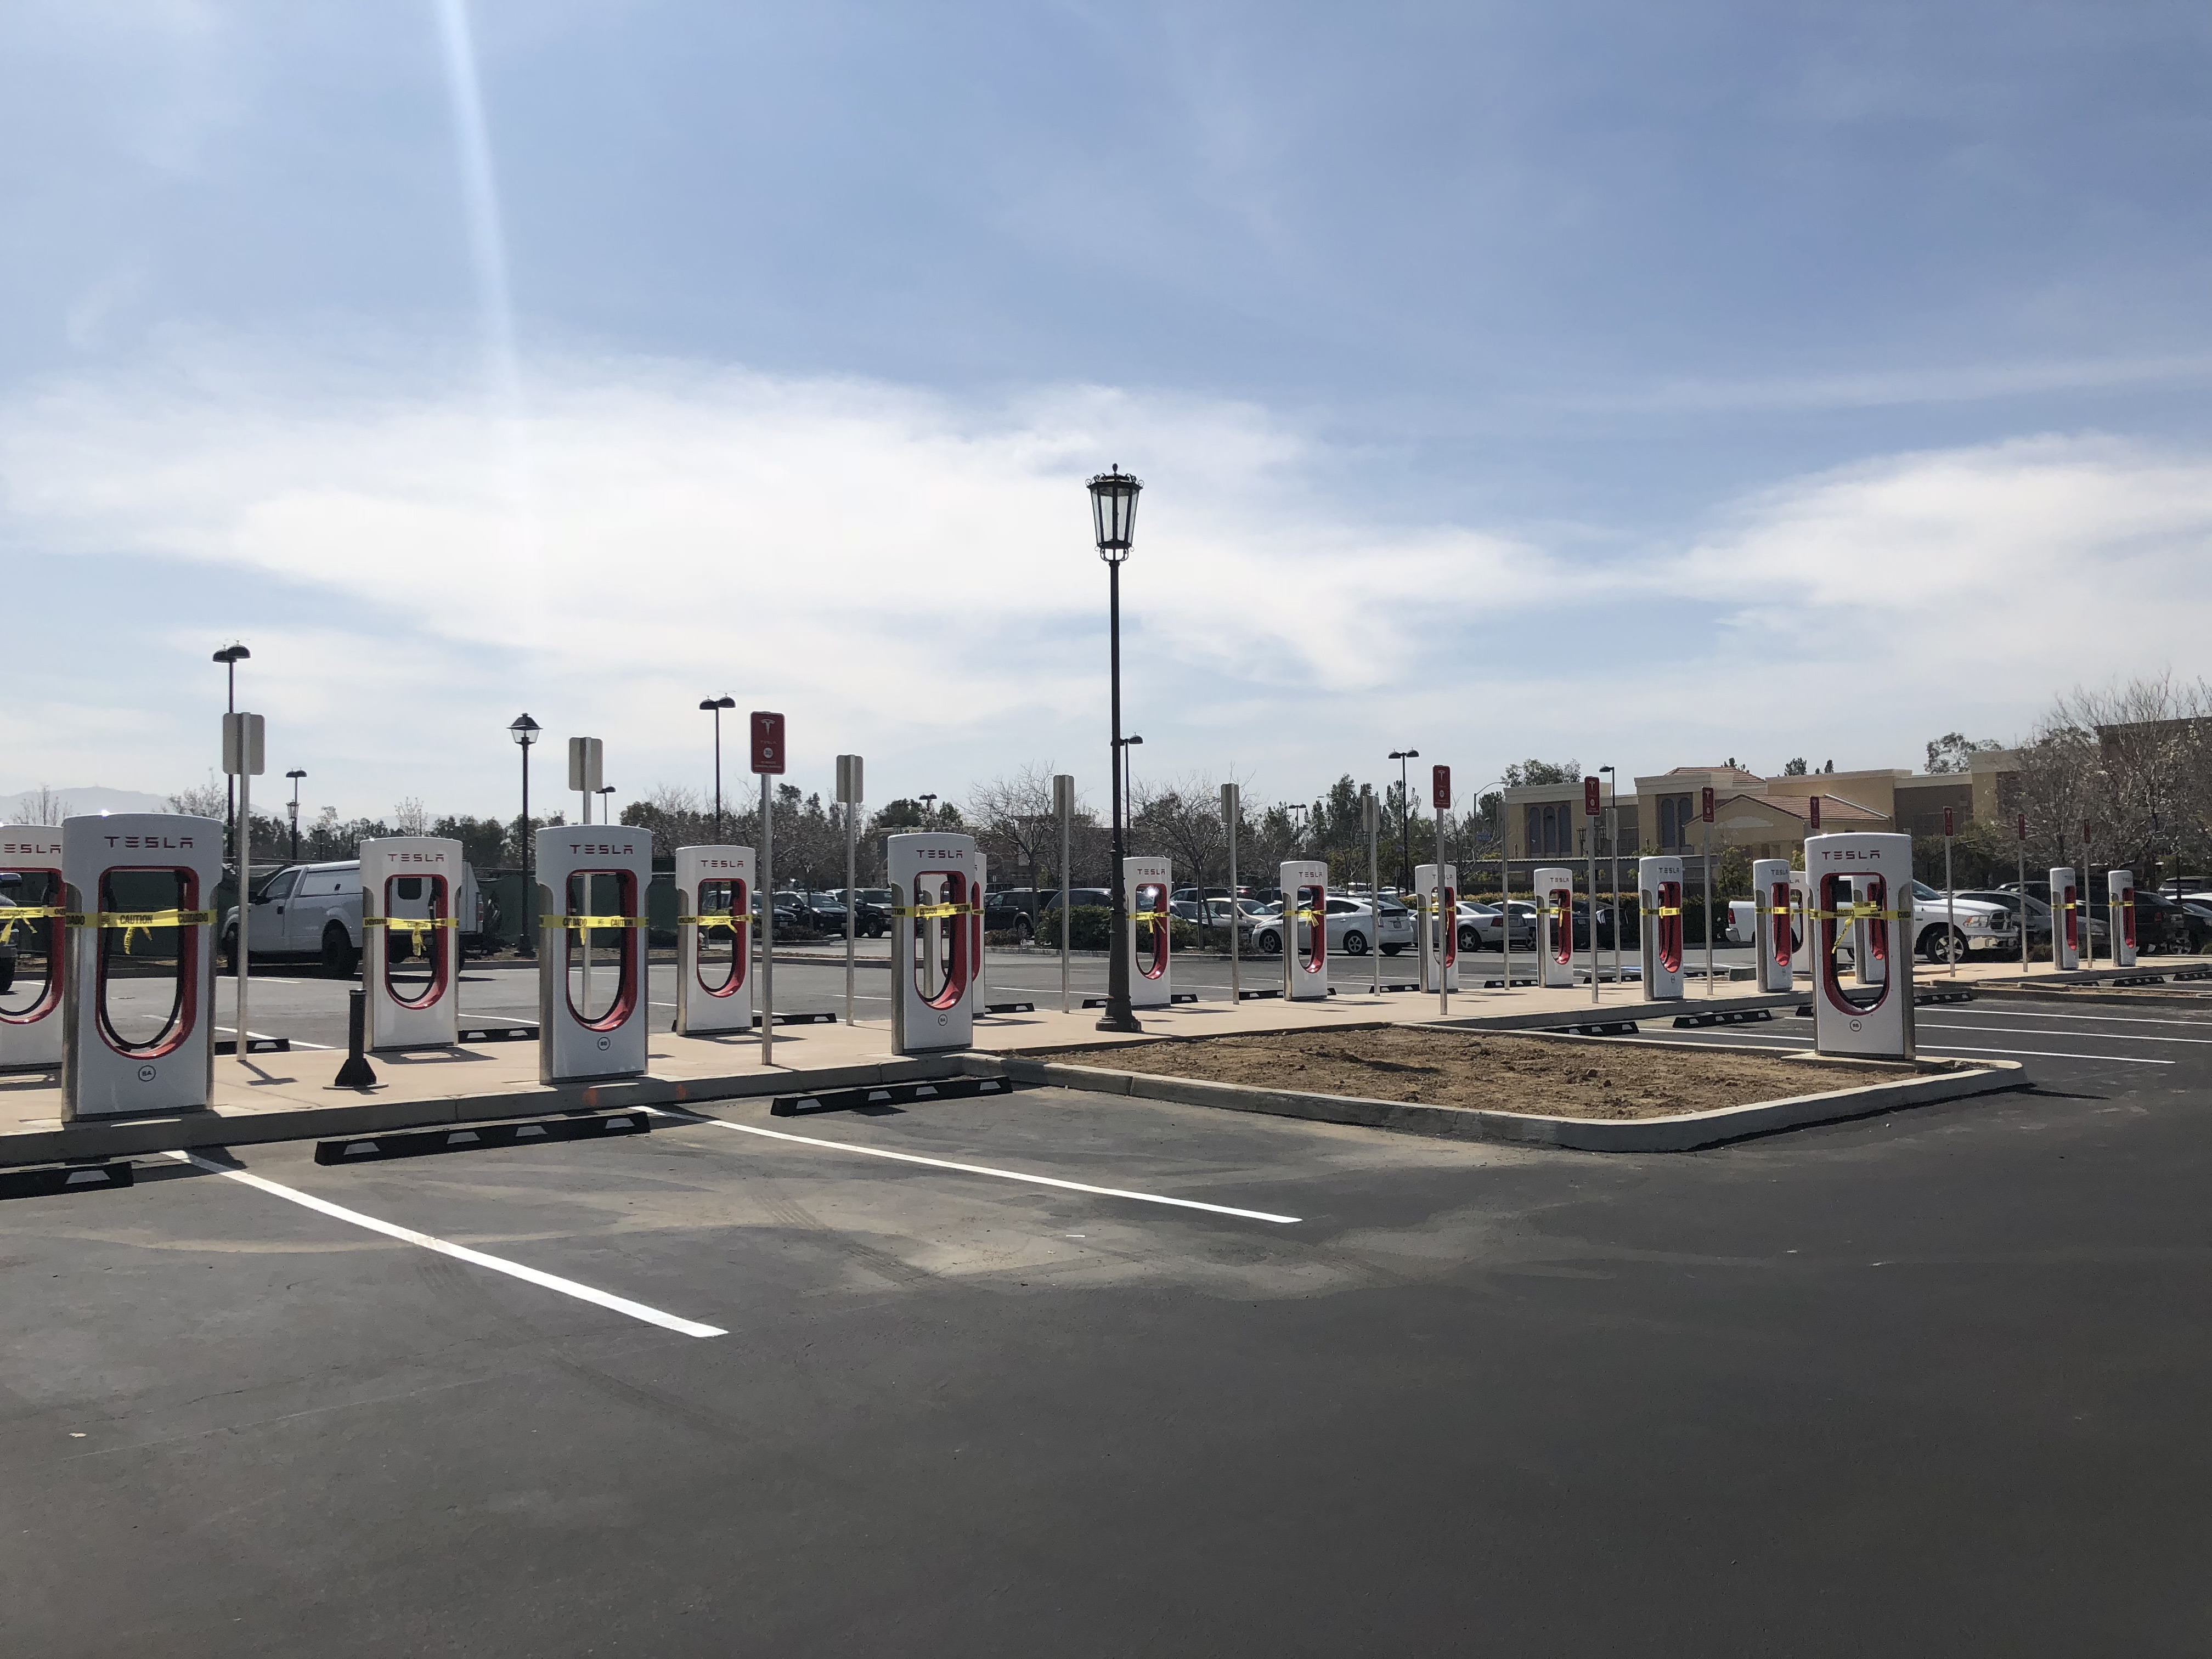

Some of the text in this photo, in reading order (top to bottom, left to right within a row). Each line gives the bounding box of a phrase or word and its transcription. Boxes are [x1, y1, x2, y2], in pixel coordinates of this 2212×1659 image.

[104, 836, 194, 848] TESLA
[3, 844, 61, 854] ESLA
[569, 844, 633, 854] TESLA
[388, 854, 444, 862] TESLA
[916, 850, 963, 859] TESLA
[1821, 850, 1880, 860] TESLA
[701, 860, 744, 868] TESLA
[120, 915, 153, 924] CAUTION
[563, 918, 588, 926] CUIDADO
